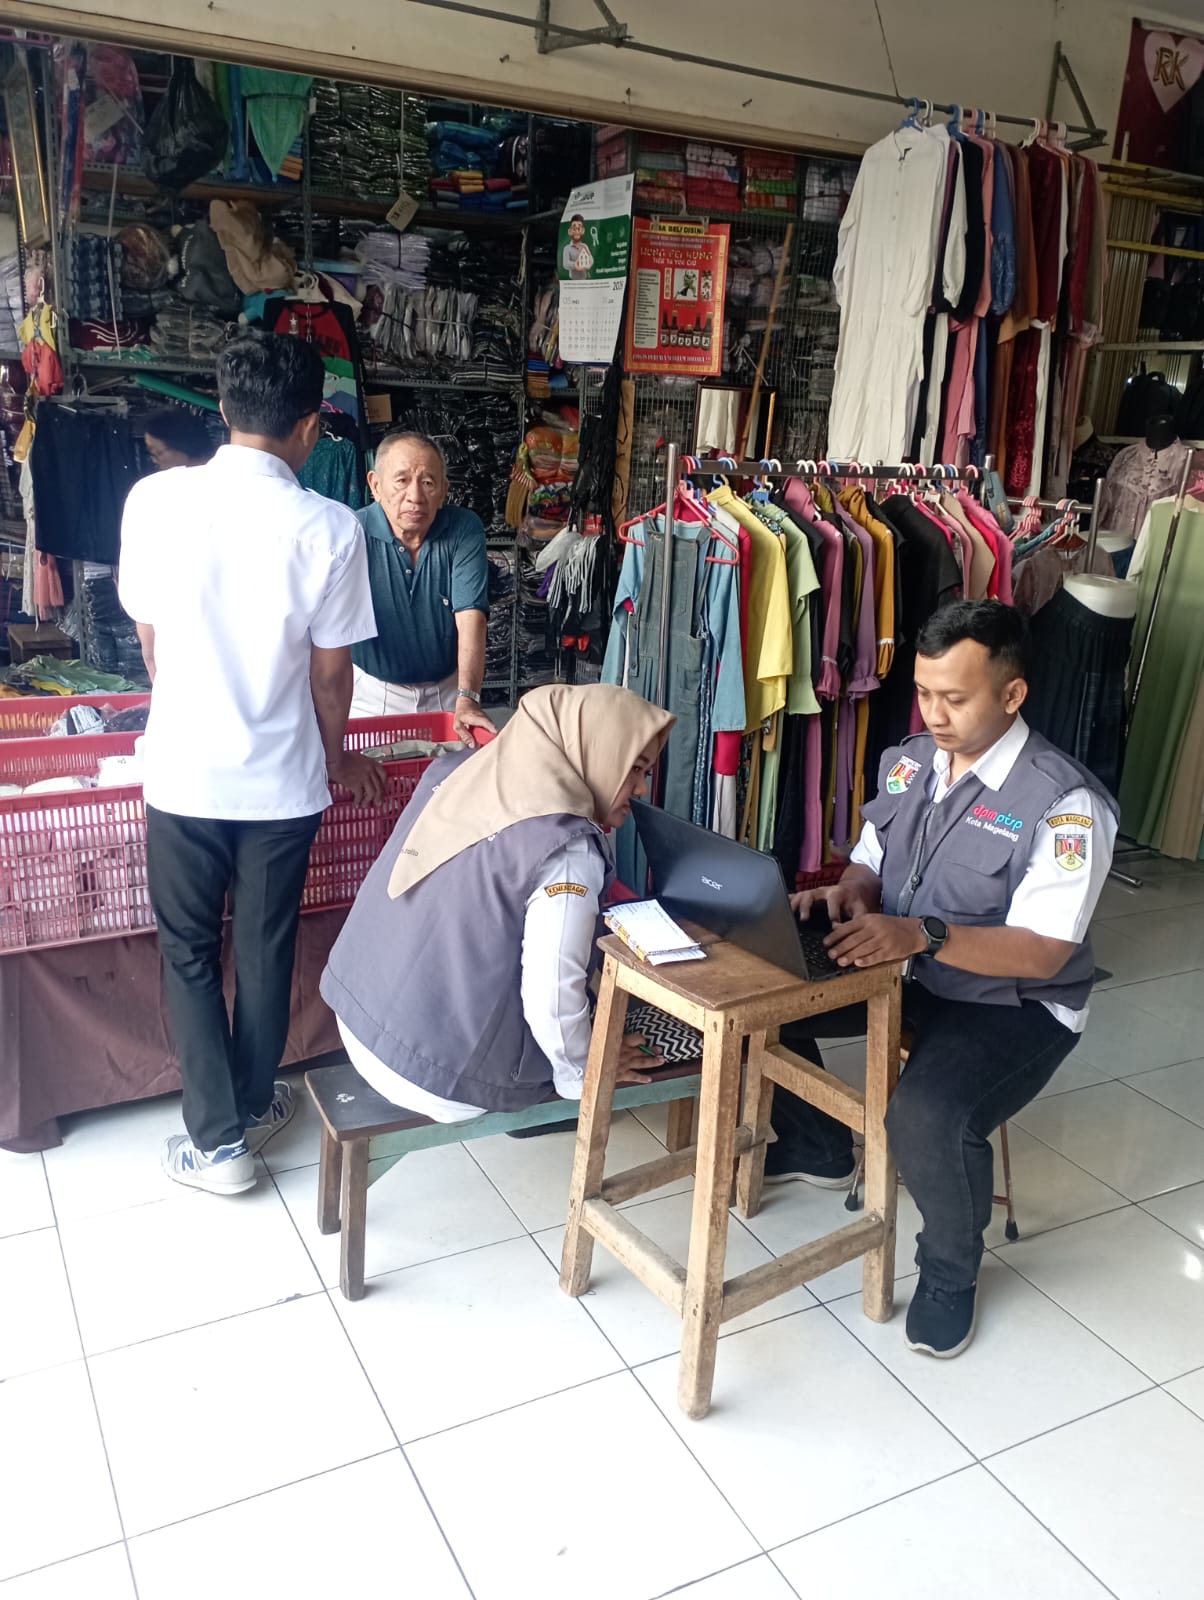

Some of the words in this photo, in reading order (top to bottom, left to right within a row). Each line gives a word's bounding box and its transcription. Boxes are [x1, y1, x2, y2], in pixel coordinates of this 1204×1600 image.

[1153, 46, 1190, 92] RK
[965, 815, 981, 828] Kota
[982, 821, 1019, 842] Magelang
[1050, 816, 1064, 825] KOTA
[1065, 815, 1091, 826] MAGELANG
[701, 875, 723, 891] acer
[272, 1100, 285, 1122] N
[181, 1150, 195, 1171] N
